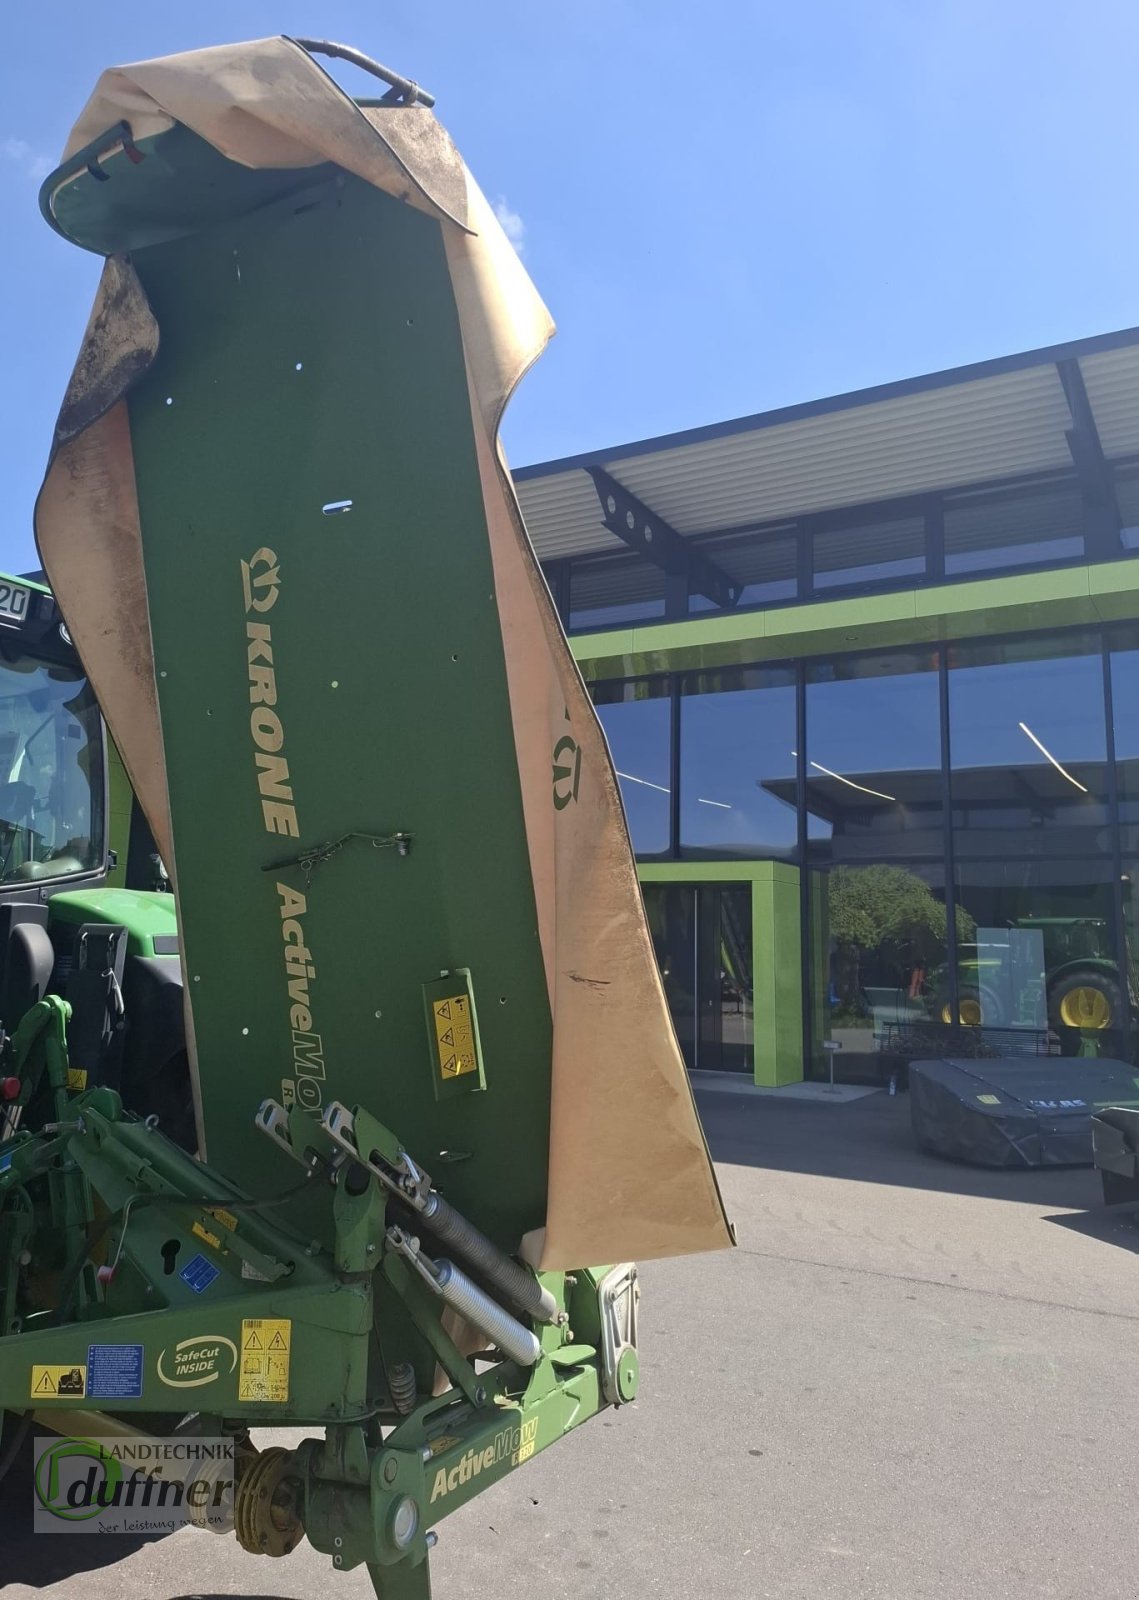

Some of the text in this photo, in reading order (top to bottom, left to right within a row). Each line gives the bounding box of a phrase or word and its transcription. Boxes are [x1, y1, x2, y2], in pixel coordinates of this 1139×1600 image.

[246, 621, 300, 838] KRONE
[276, 882, 326, 1124] ActiveMo
[174, 1347, 219, 1363] SafeCut
[176, 1359, 216, 1376] INSIDE
[430, 1416, 538, 1504] ActiveMow
